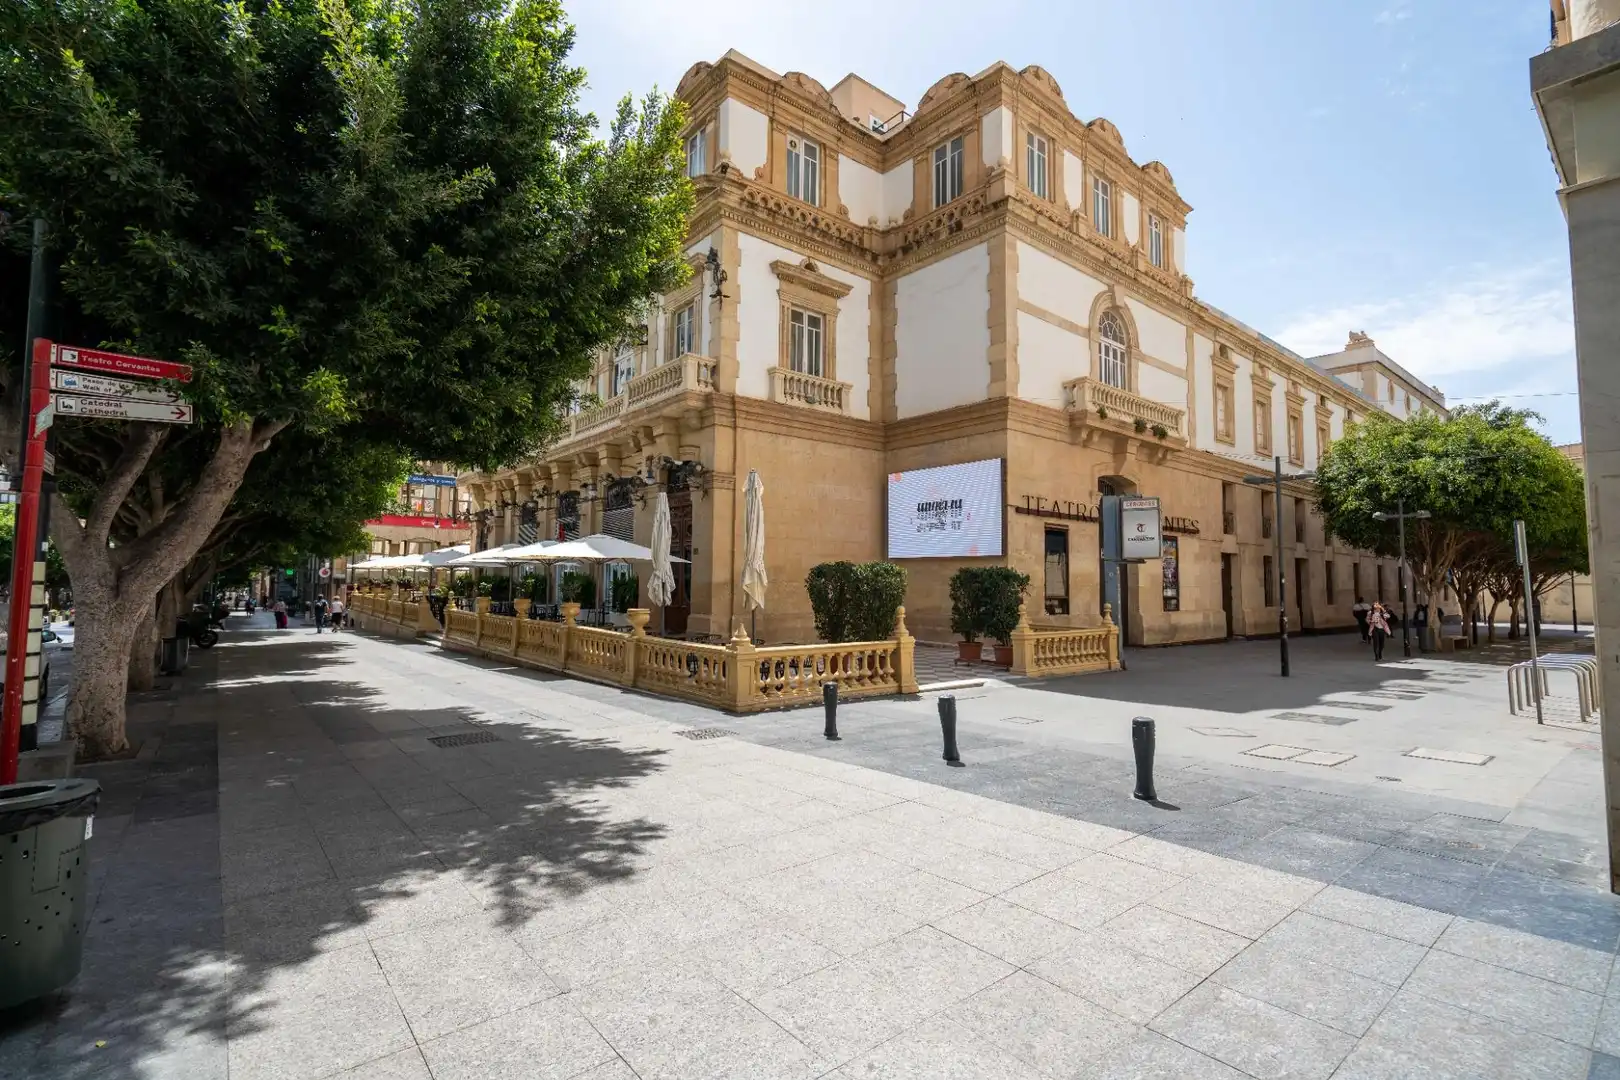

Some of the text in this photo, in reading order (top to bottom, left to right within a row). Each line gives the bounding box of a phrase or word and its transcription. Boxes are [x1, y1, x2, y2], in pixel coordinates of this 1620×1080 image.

[82, 354, 161, 373] Teatro Cervantes
[82, 377, 104, 385] Paseo
[82, 384, 101, 392] Walk
[80, 398, 123, 409] Catedral
[80, 407, 128, 417] Cathedral
[1022, 495, 1101, 523] TEATRO
